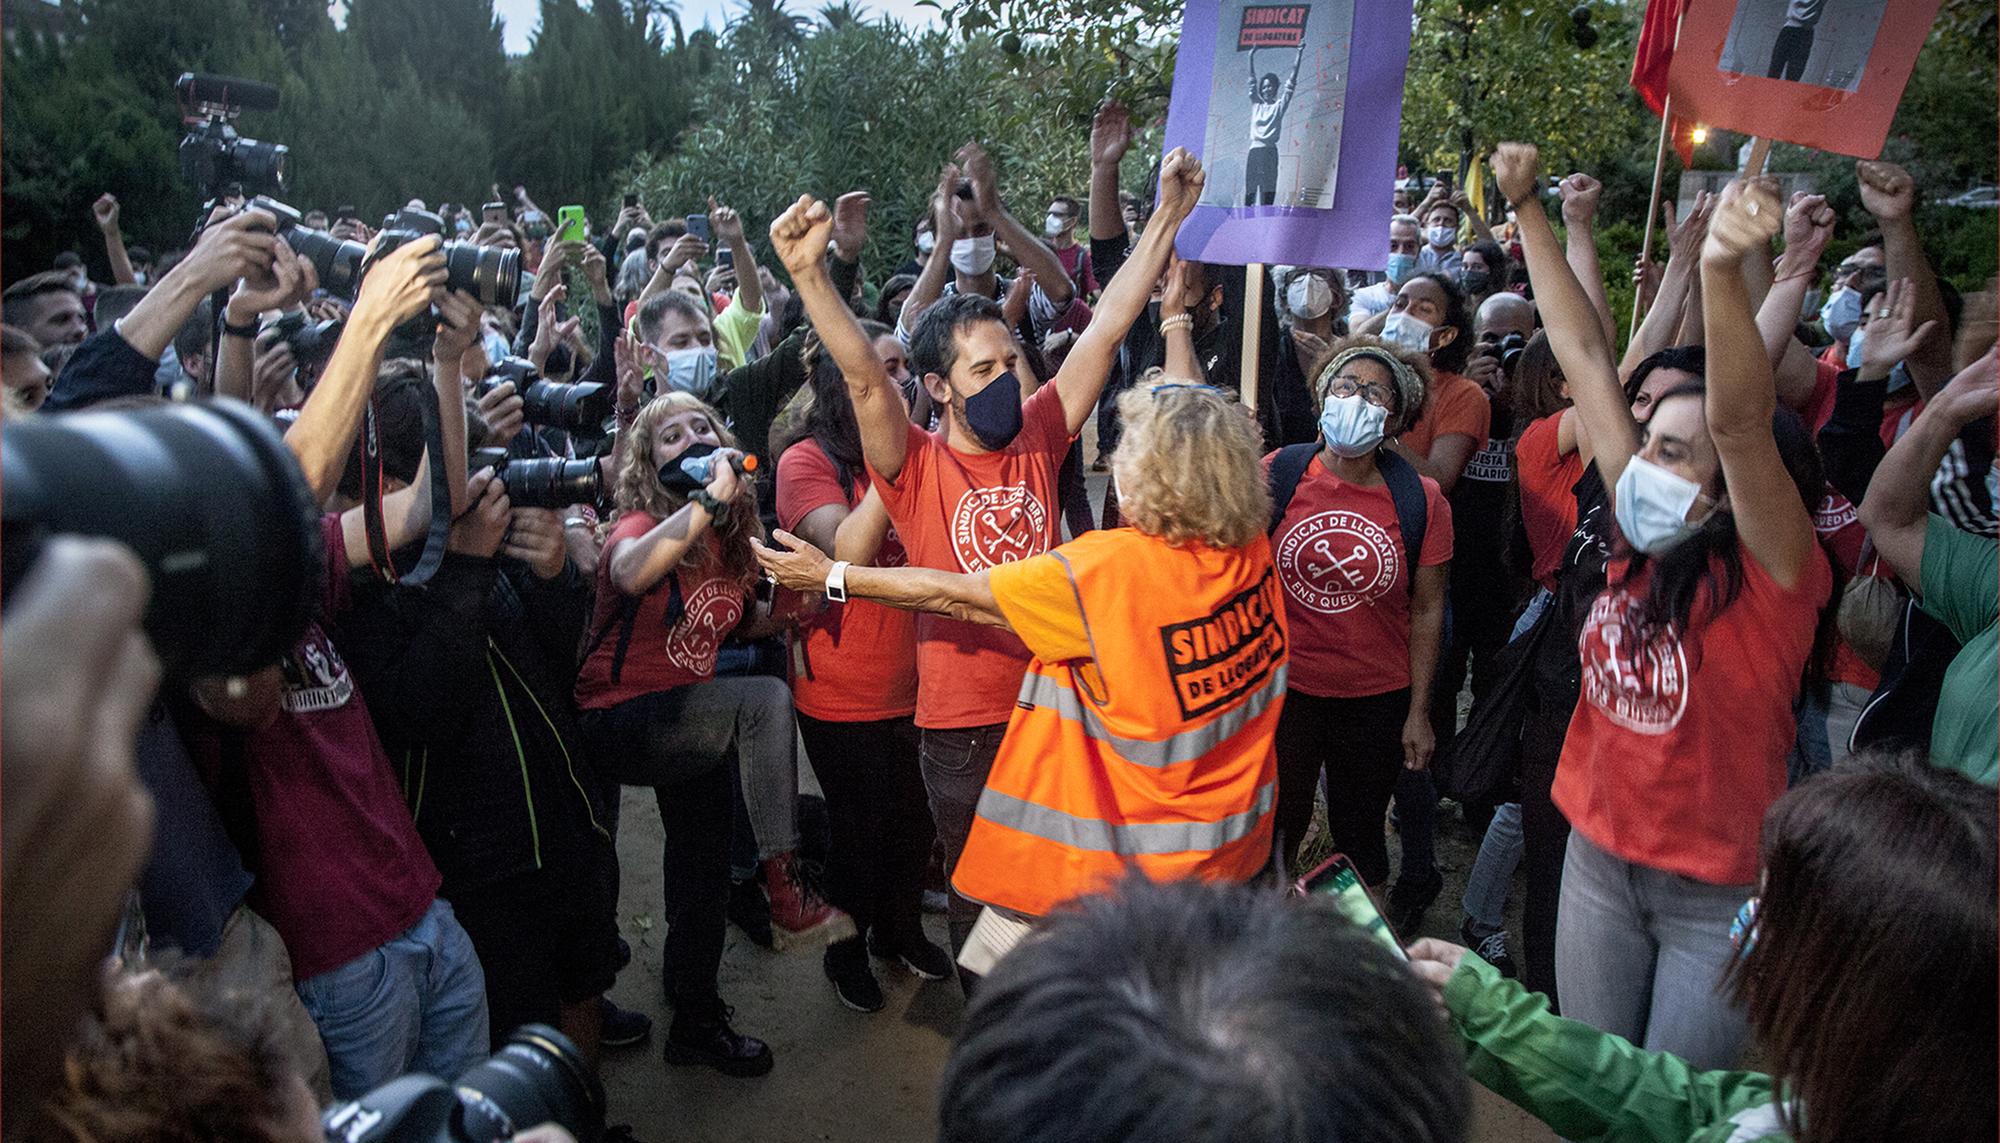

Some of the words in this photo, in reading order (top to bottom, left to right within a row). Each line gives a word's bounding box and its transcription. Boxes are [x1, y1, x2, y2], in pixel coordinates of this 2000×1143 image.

[1244, 7, 1306, 24] SINDICAT
[1473, 453, 1504, 466] UESTA
[1466, 464, 1509, 480] SALARIO
[958, 496, 981, 545] SINDIC
[980, 493, 999, 507] DE
[1281, 519, 1324, 569] SINDICAT
[1329, 516, 1348, 528] DE
[1350, 518, 1394, 588] LLOGATERES
[1291, 581, 1317, 604] ENS
[1319, 592, 1376, 608] QUED
[1188, 677, 1214, 699] DE
